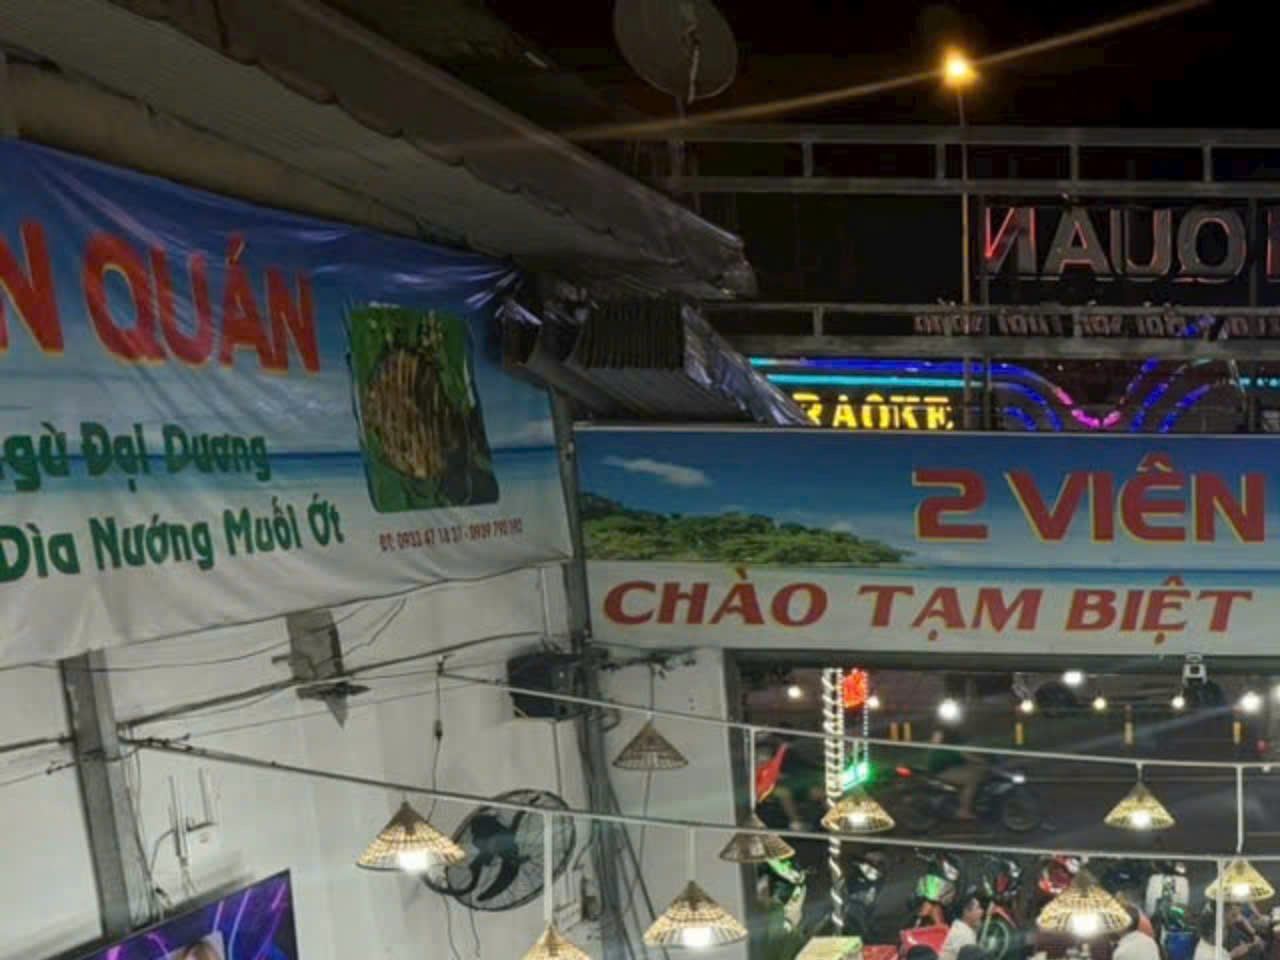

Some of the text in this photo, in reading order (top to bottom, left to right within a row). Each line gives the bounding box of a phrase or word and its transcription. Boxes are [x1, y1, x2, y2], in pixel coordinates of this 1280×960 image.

[84, 232, 320, 376] QUÁN
[81, 422, 151, 492] Đại
[89, 513, 214, 571] Nướng
[223, 496, 303, 555] Muối
[308, 492, 344, 547] Ớt
[912, 468, 989, 542] 2
[1004, 453, 1266, 543] VIÊN
[602, 567, 828, 628] CHÀO
[857, 584, 1043, 642] TẠM
[1065, 575, 1251, 645] BIỆT
